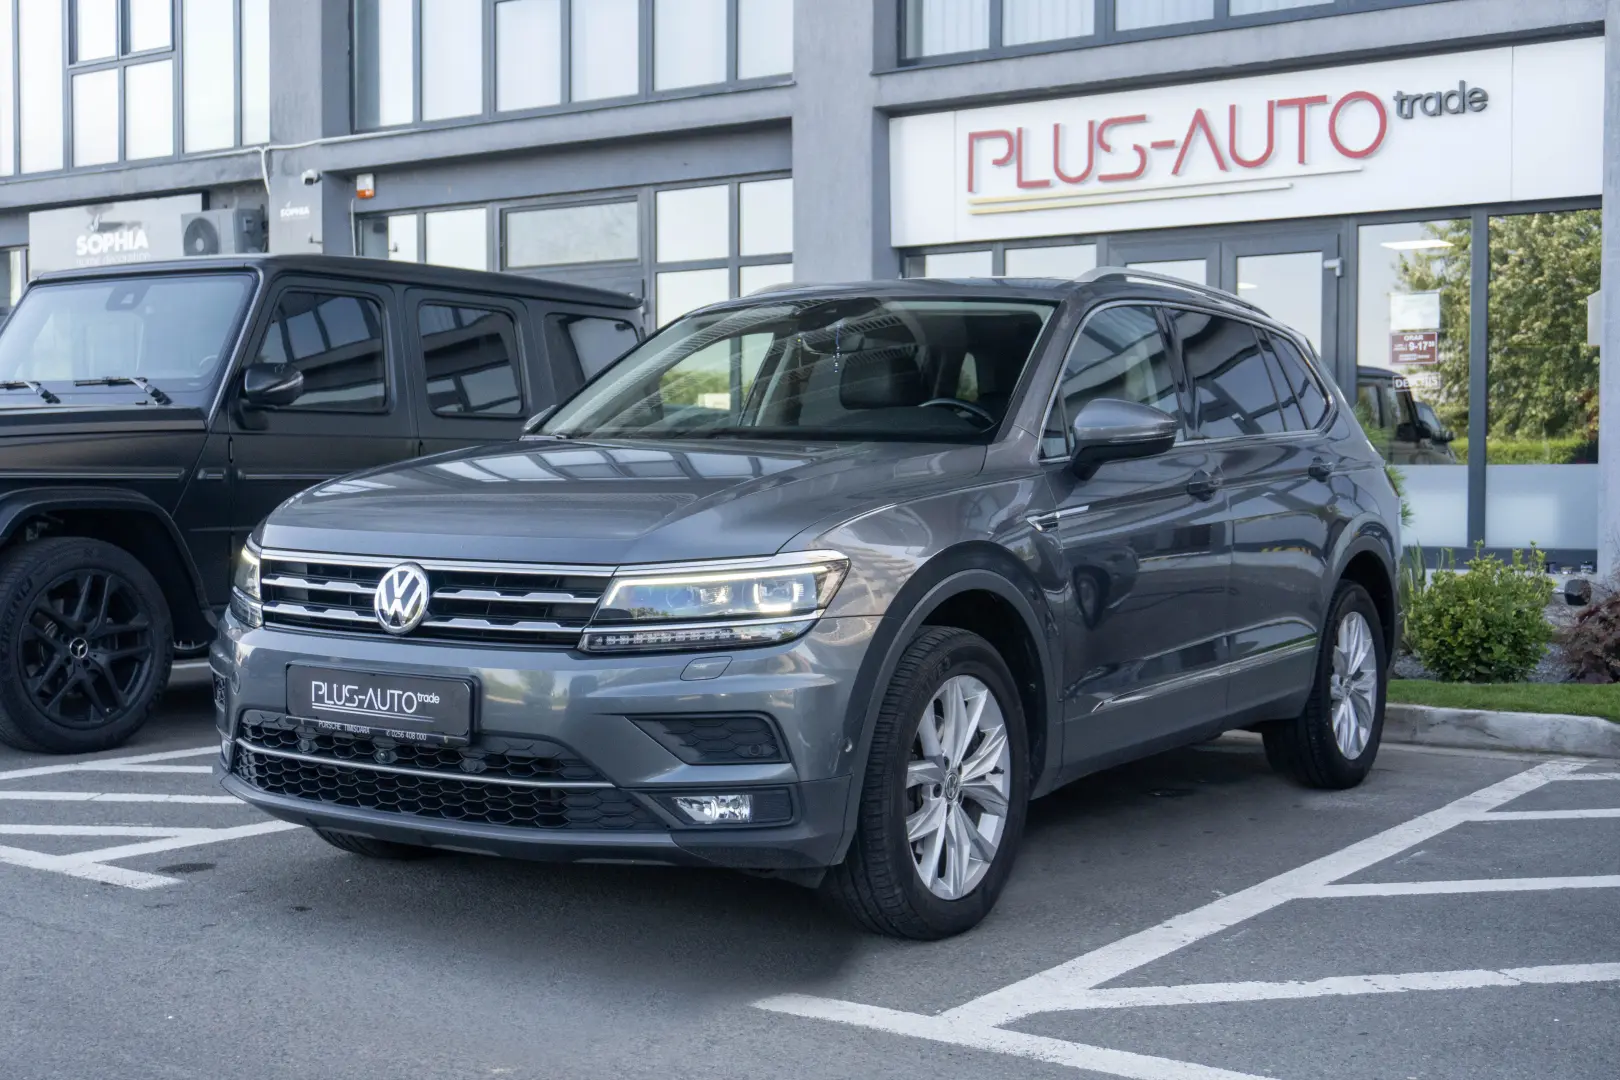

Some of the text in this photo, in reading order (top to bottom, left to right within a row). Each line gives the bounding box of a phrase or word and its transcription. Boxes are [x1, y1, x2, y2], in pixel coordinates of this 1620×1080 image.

[968, 80, 1489, 193] PLUS-AUTO trade
[76, 229, 149, 255] SOPHIA
[311, 681, 440, 714] PLUS-AUTO trade
[319, 720, 341, 730] PORSCHE
